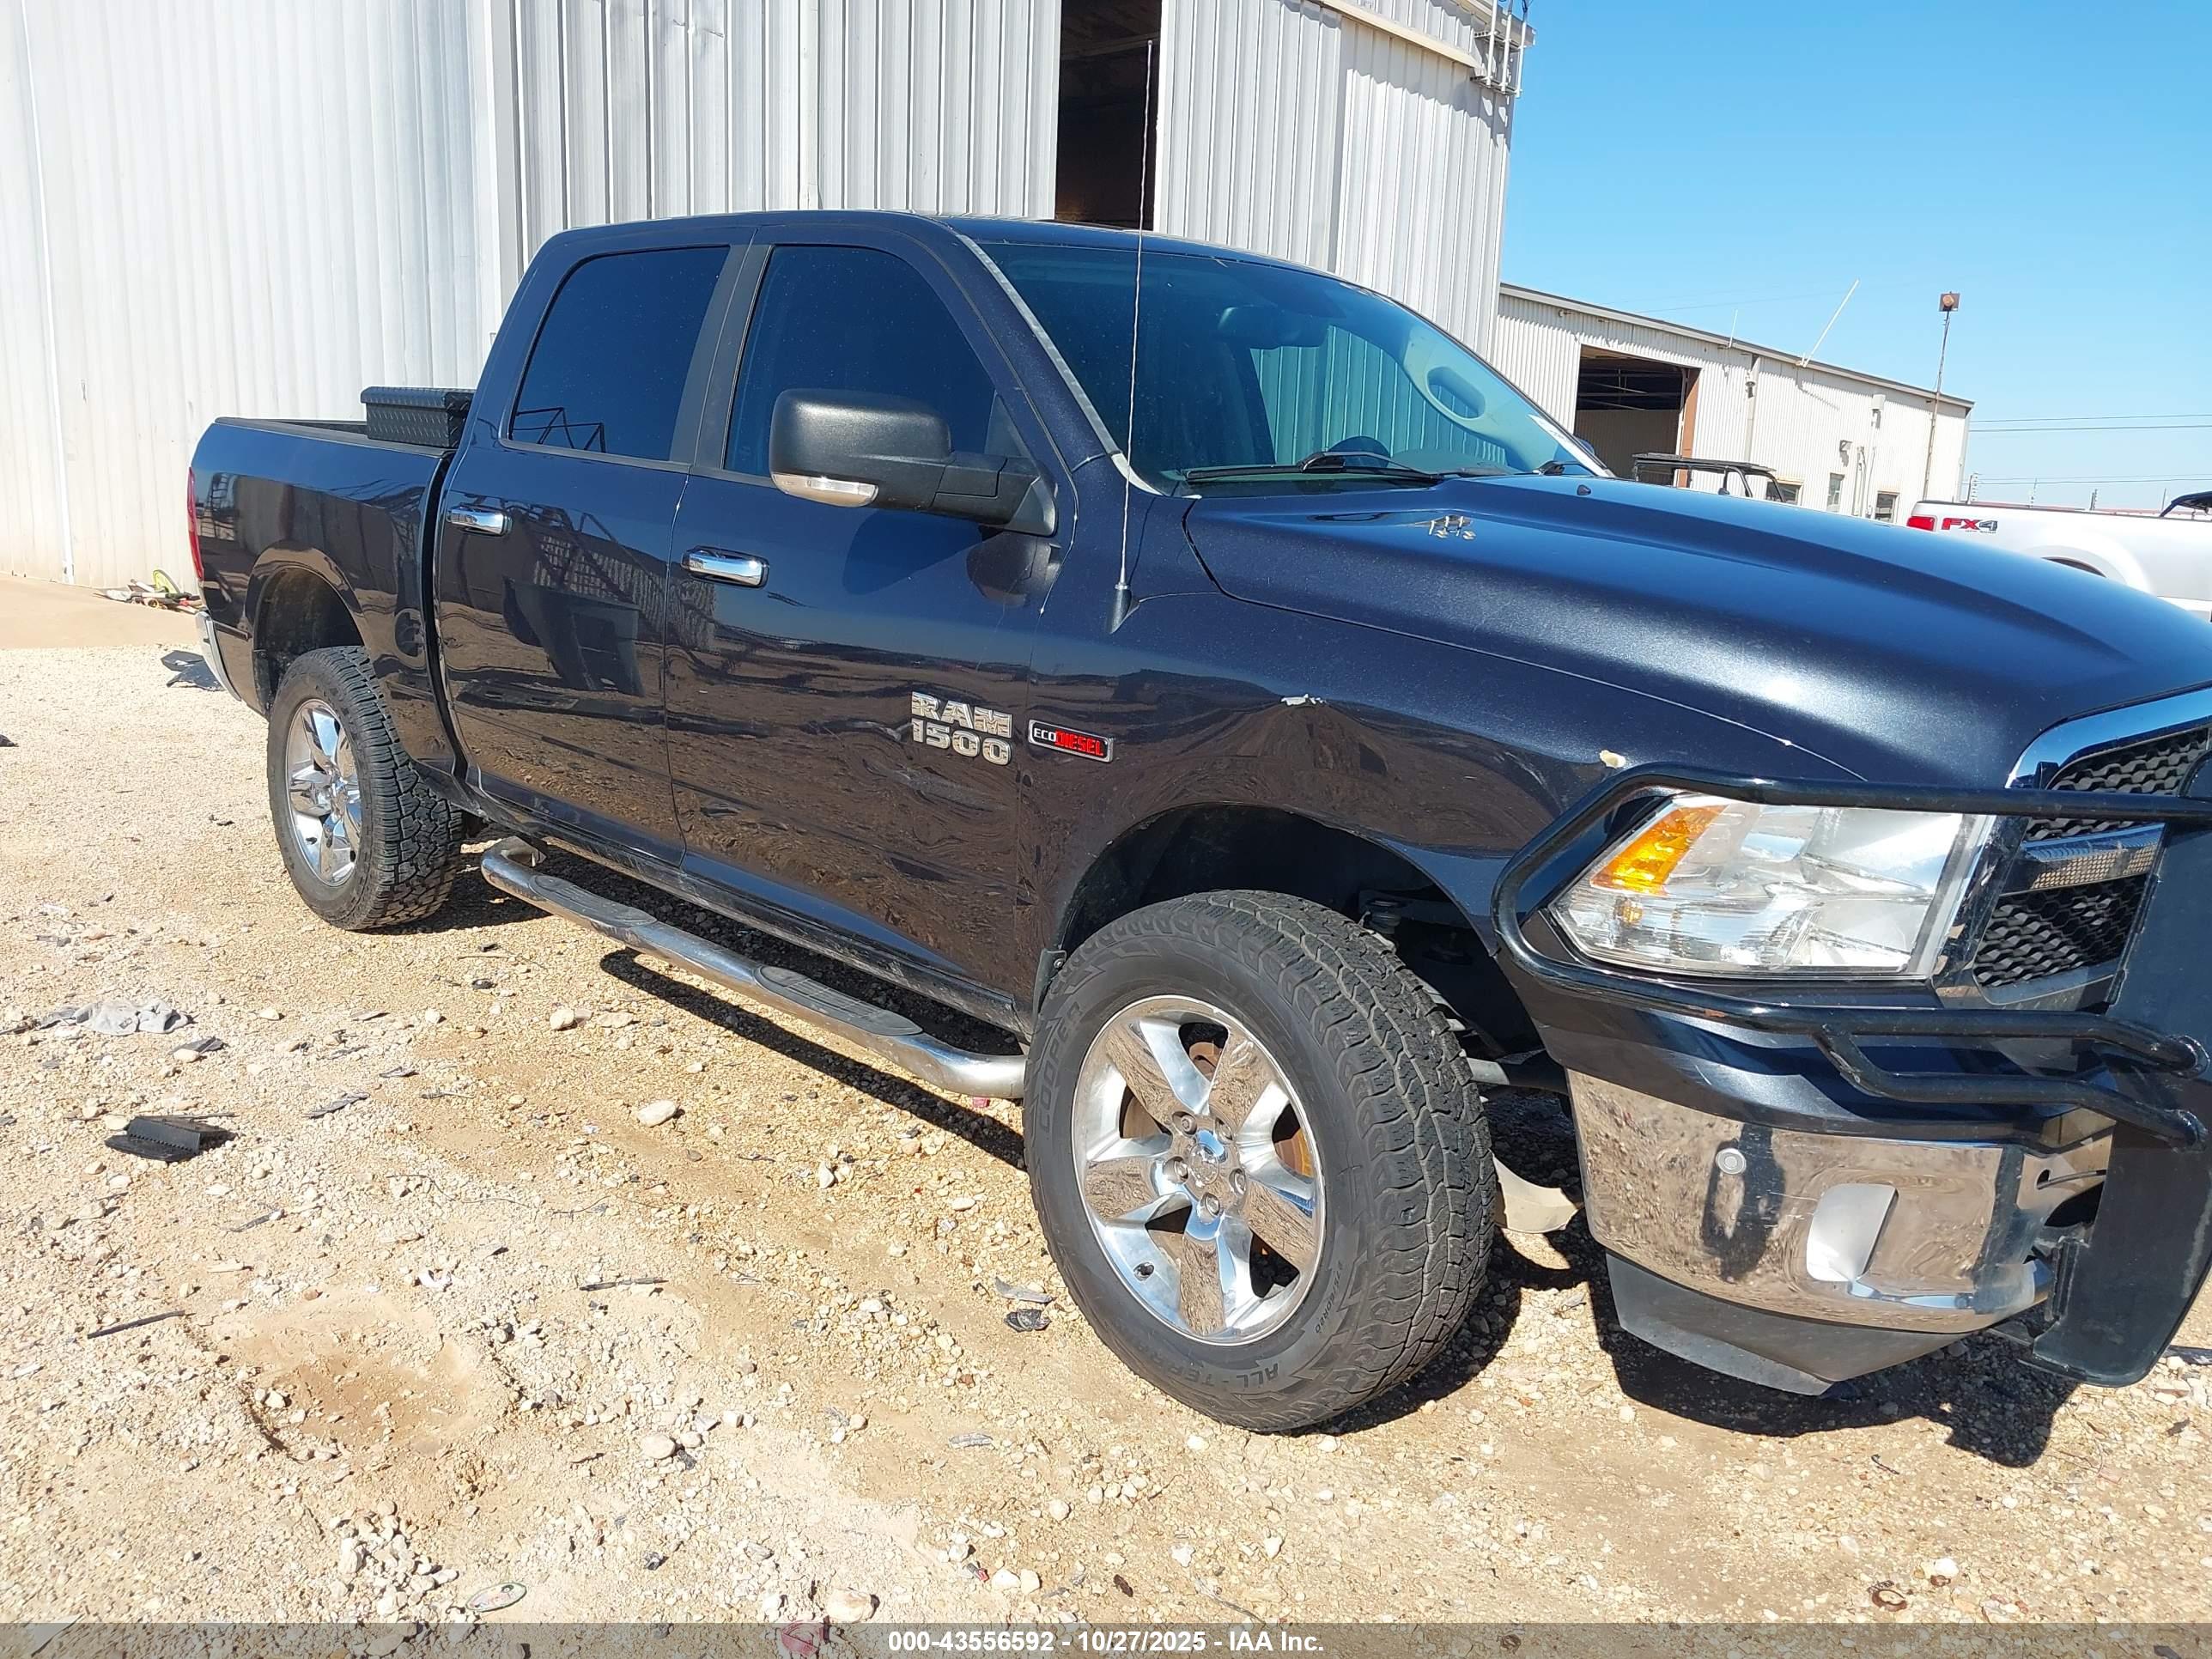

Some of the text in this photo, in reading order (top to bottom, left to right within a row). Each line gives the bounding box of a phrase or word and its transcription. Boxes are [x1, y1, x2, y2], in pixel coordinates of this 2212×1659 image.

[1942, 518, 1998, 532] FX4
[911, 691, 1012, 738] RAM
[911, 717, 1012, 766] 1500
[1039, 1002, 1083, 1133] COOPER
